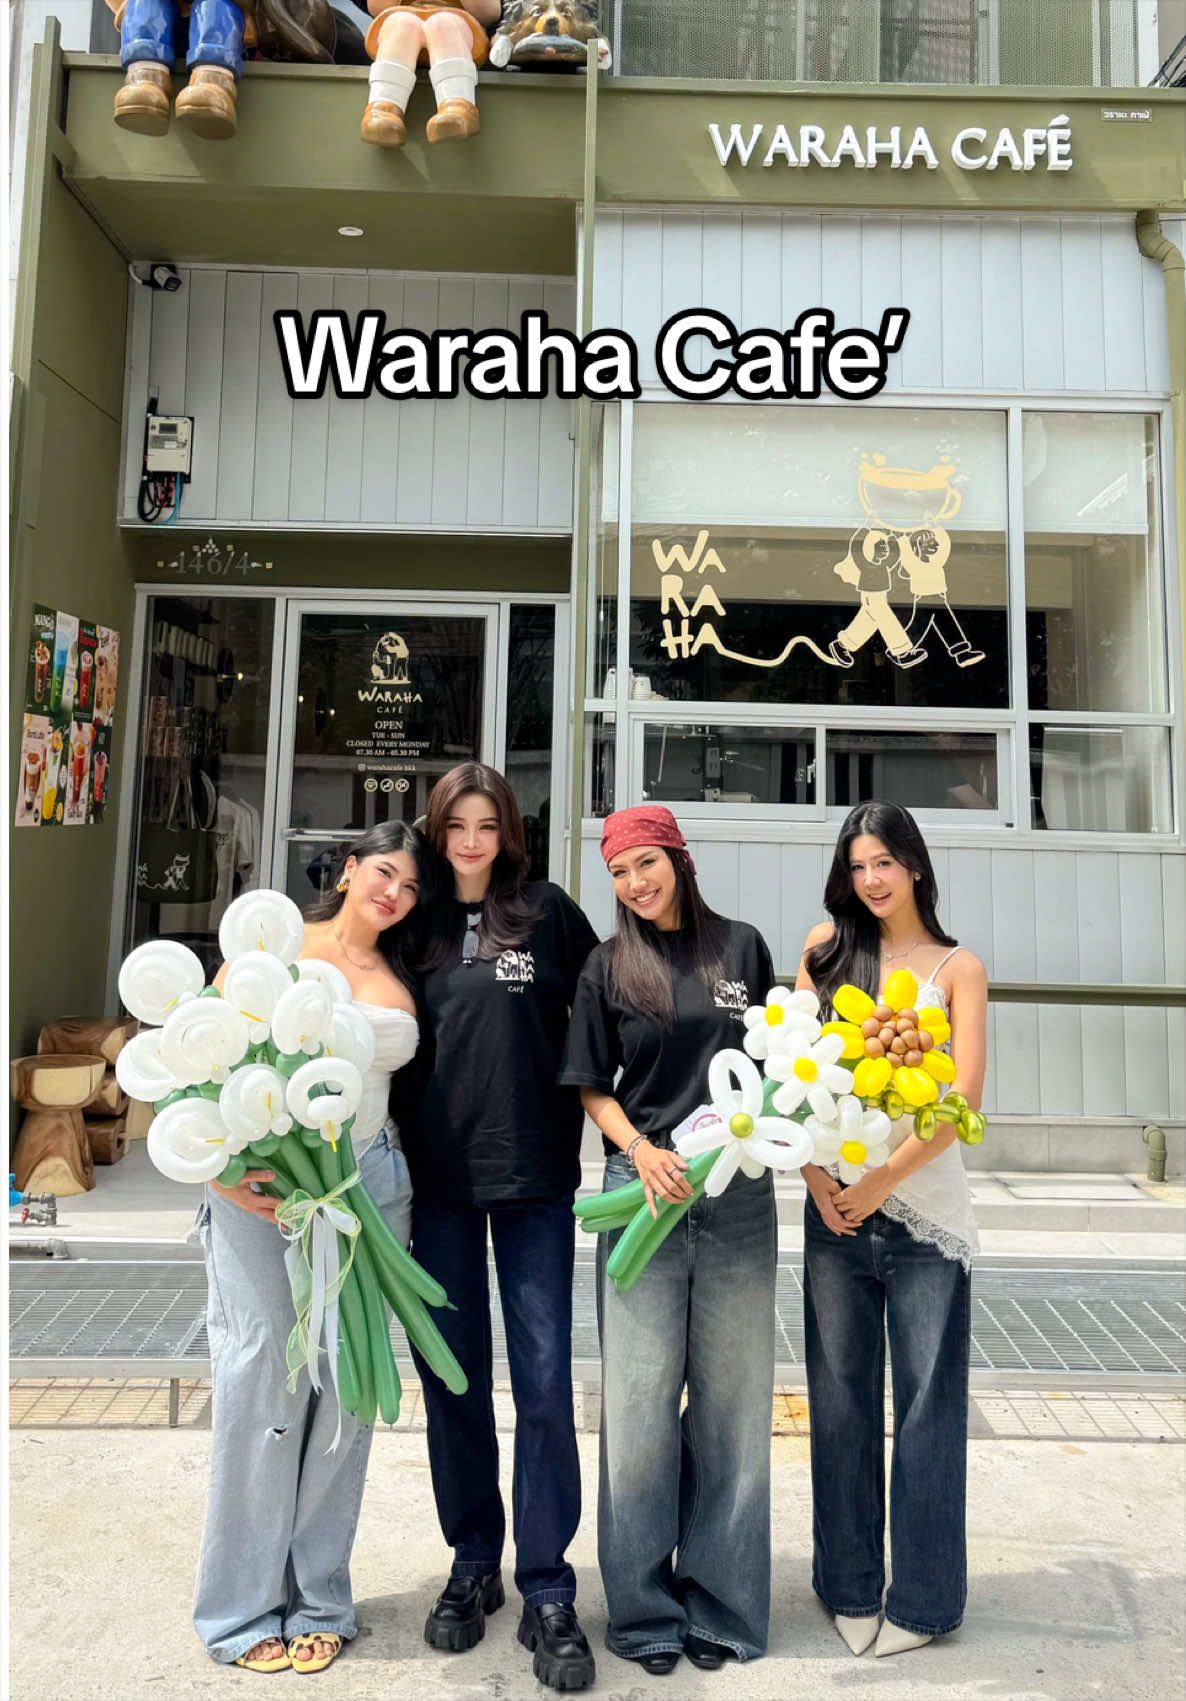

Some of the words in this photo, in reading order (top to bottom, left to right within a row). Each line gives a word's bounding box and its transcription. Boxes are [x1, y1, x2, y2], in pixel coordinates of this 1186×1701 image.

[708, 123, 940, 169] WARAHA
[951, 114, 1073, 172] CAFÉ
[176, 551, 251, 575] 146/4
[652, 530, 727, 573] WA
[661, 574, 727, 617] RA
[660, 619, 727, 659] HA
[357, 686, 423, 703] WARAHA
[374, 720, 404, 730] OPEN
[345, 739, 374, 748] CLOSED
[376, 740, 398, 749] EVERY
[398, 740, 431, 749] MONDAY
[408, 749, 420, 757] PM
